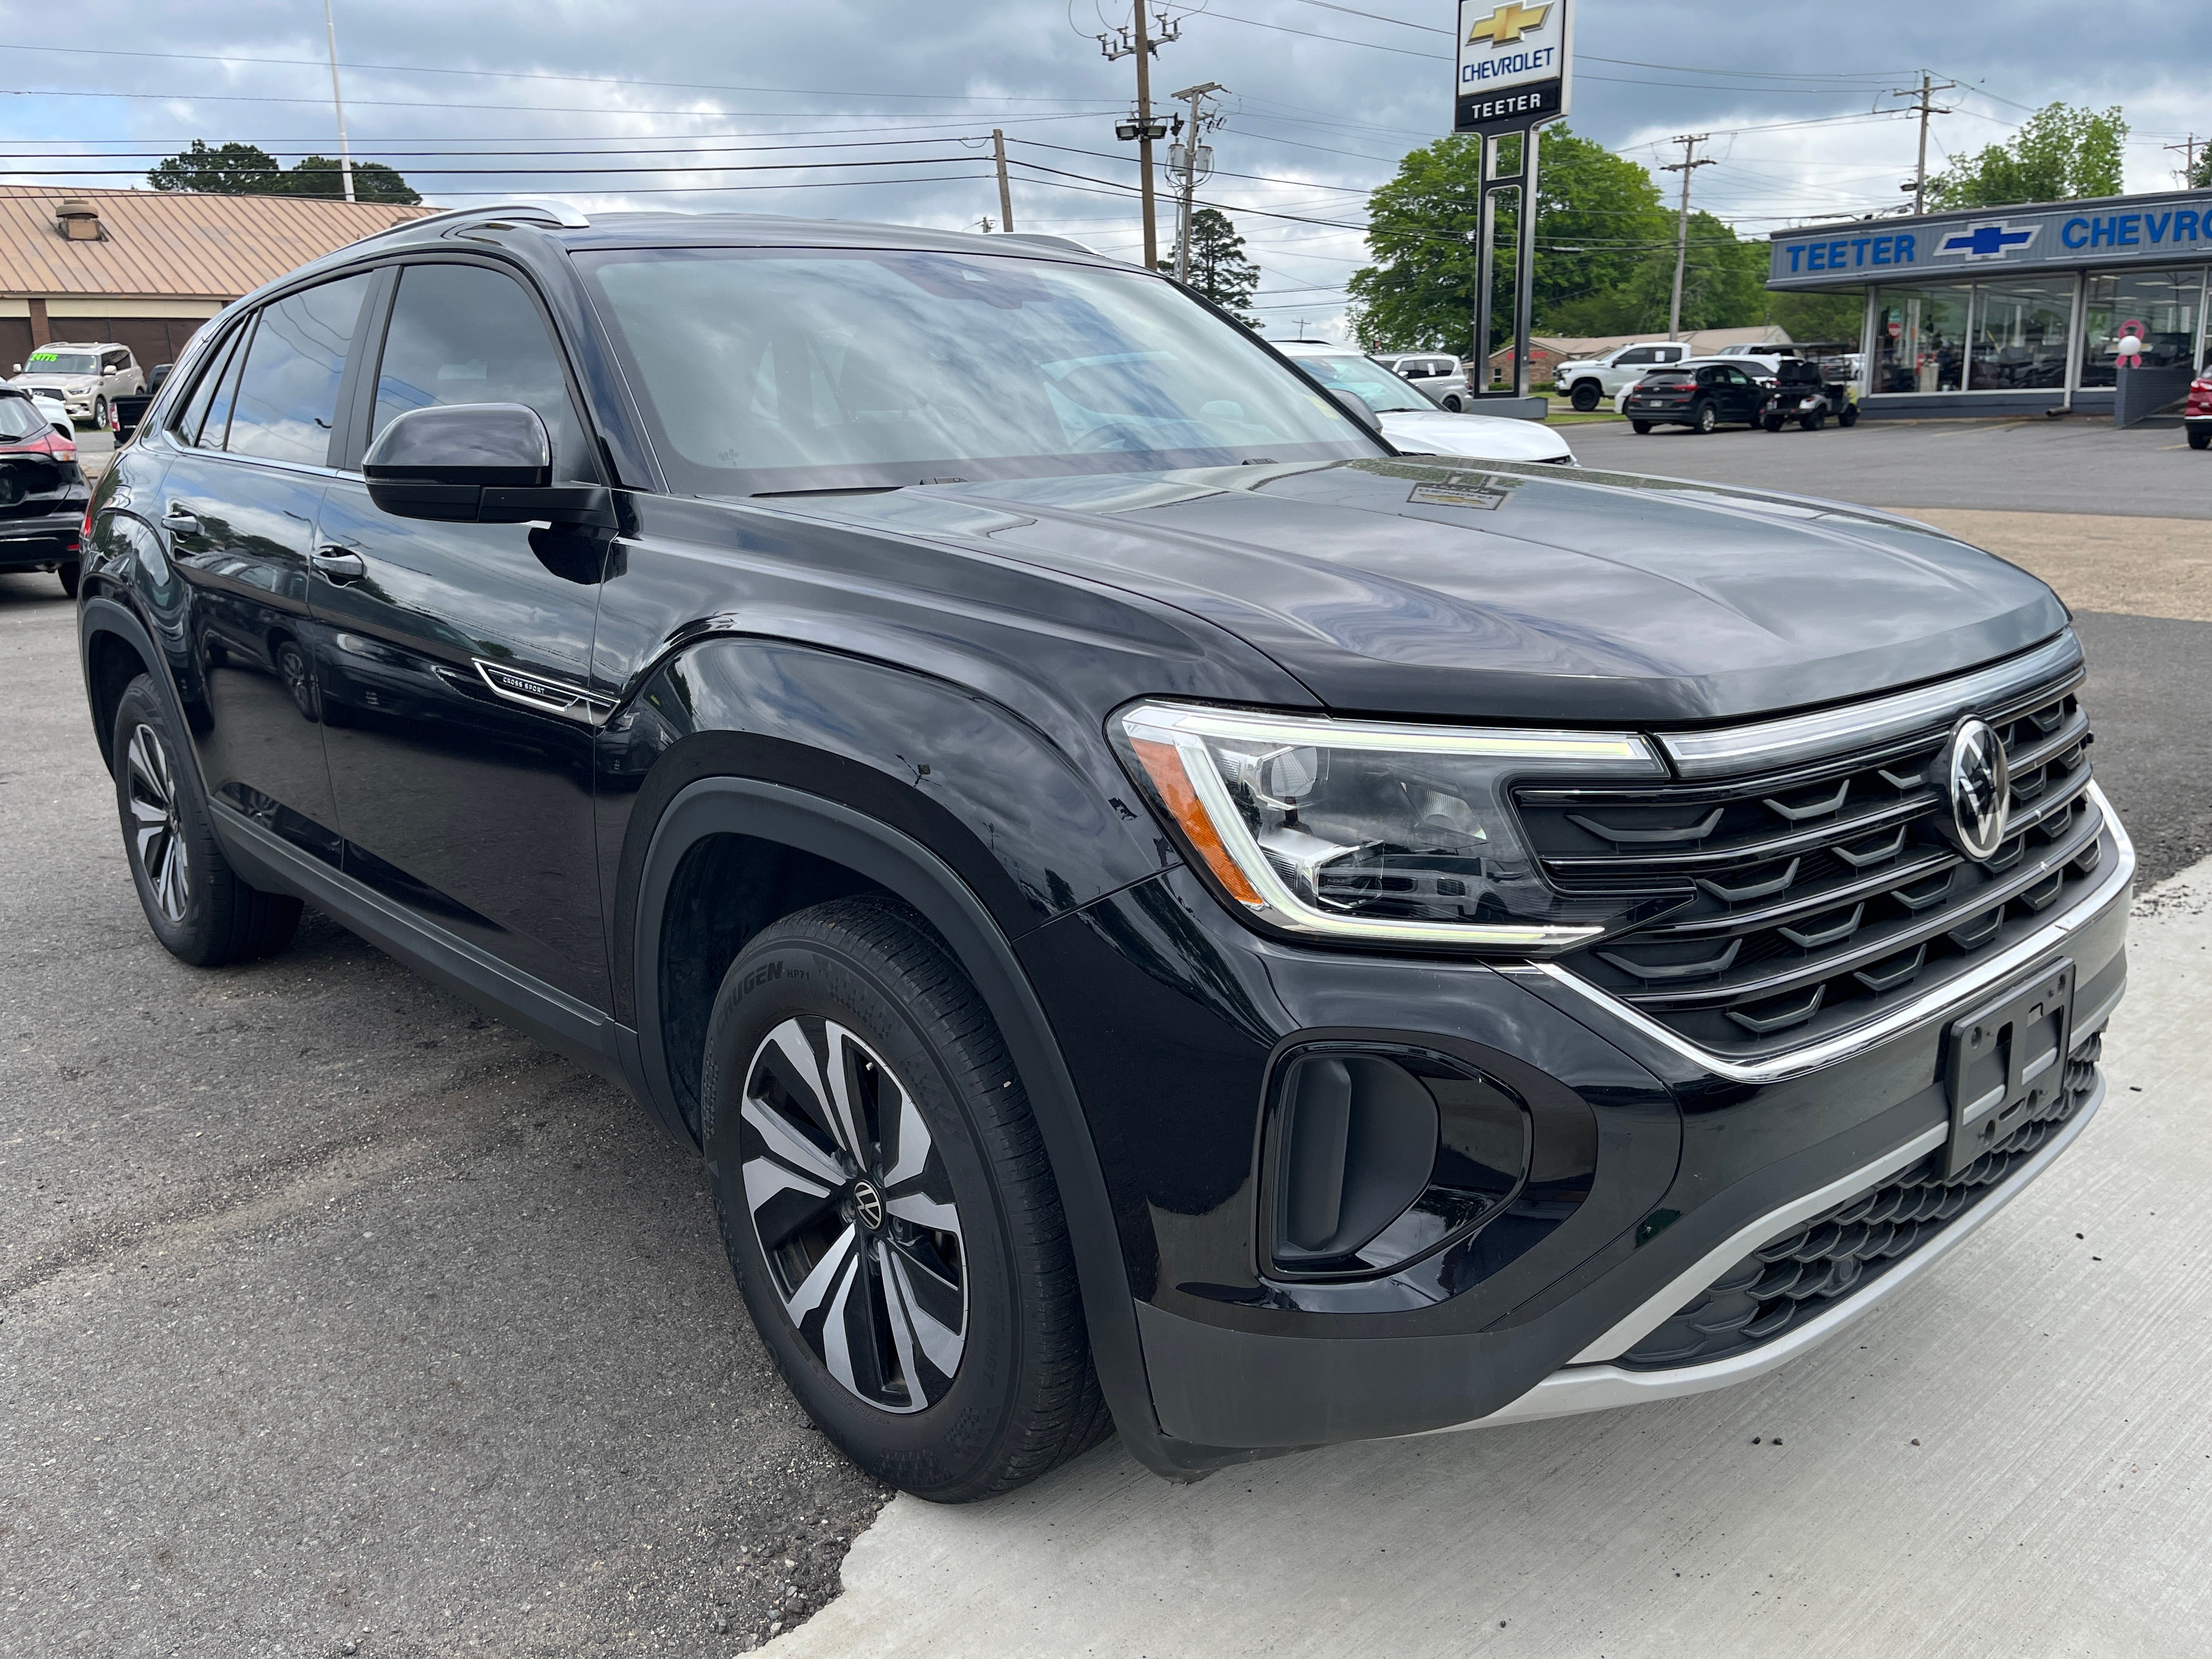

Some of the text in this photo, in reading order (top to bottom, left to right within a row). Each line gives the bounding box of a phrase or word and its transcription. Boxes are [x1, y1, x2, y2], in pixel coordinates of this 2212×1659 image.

[1463, 47, 1554, 83] CHEVROLET
[1471, 93, 1541, 119] TEETER
[1786, 234, 1916, 273] TEETER
[503, 677, 545, 694] CROSS SPORT
[716, 961, 783, 1036] CRUGEN
